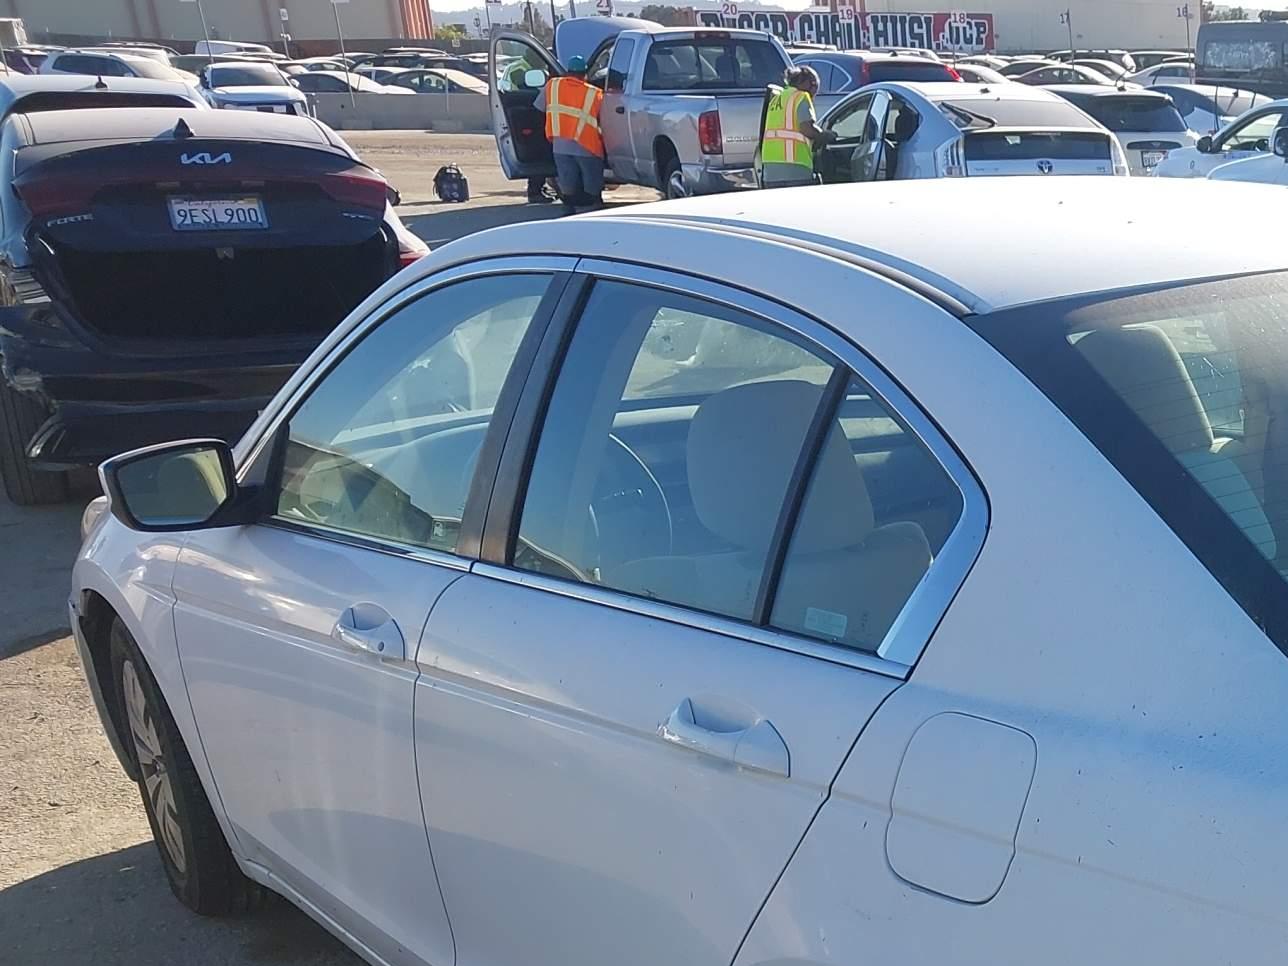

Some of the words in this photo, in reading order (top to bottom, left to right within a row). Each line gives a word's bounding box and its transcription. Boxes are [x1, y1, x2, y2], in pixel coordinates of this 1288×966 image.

[722, 4, 737, 15] 20
[839, 9, 852, 20] 19
[952, 13, 966, 24] 18
[180, 152, 232, 164] KIA
[177, 208, 258, 224] 9ESL900
